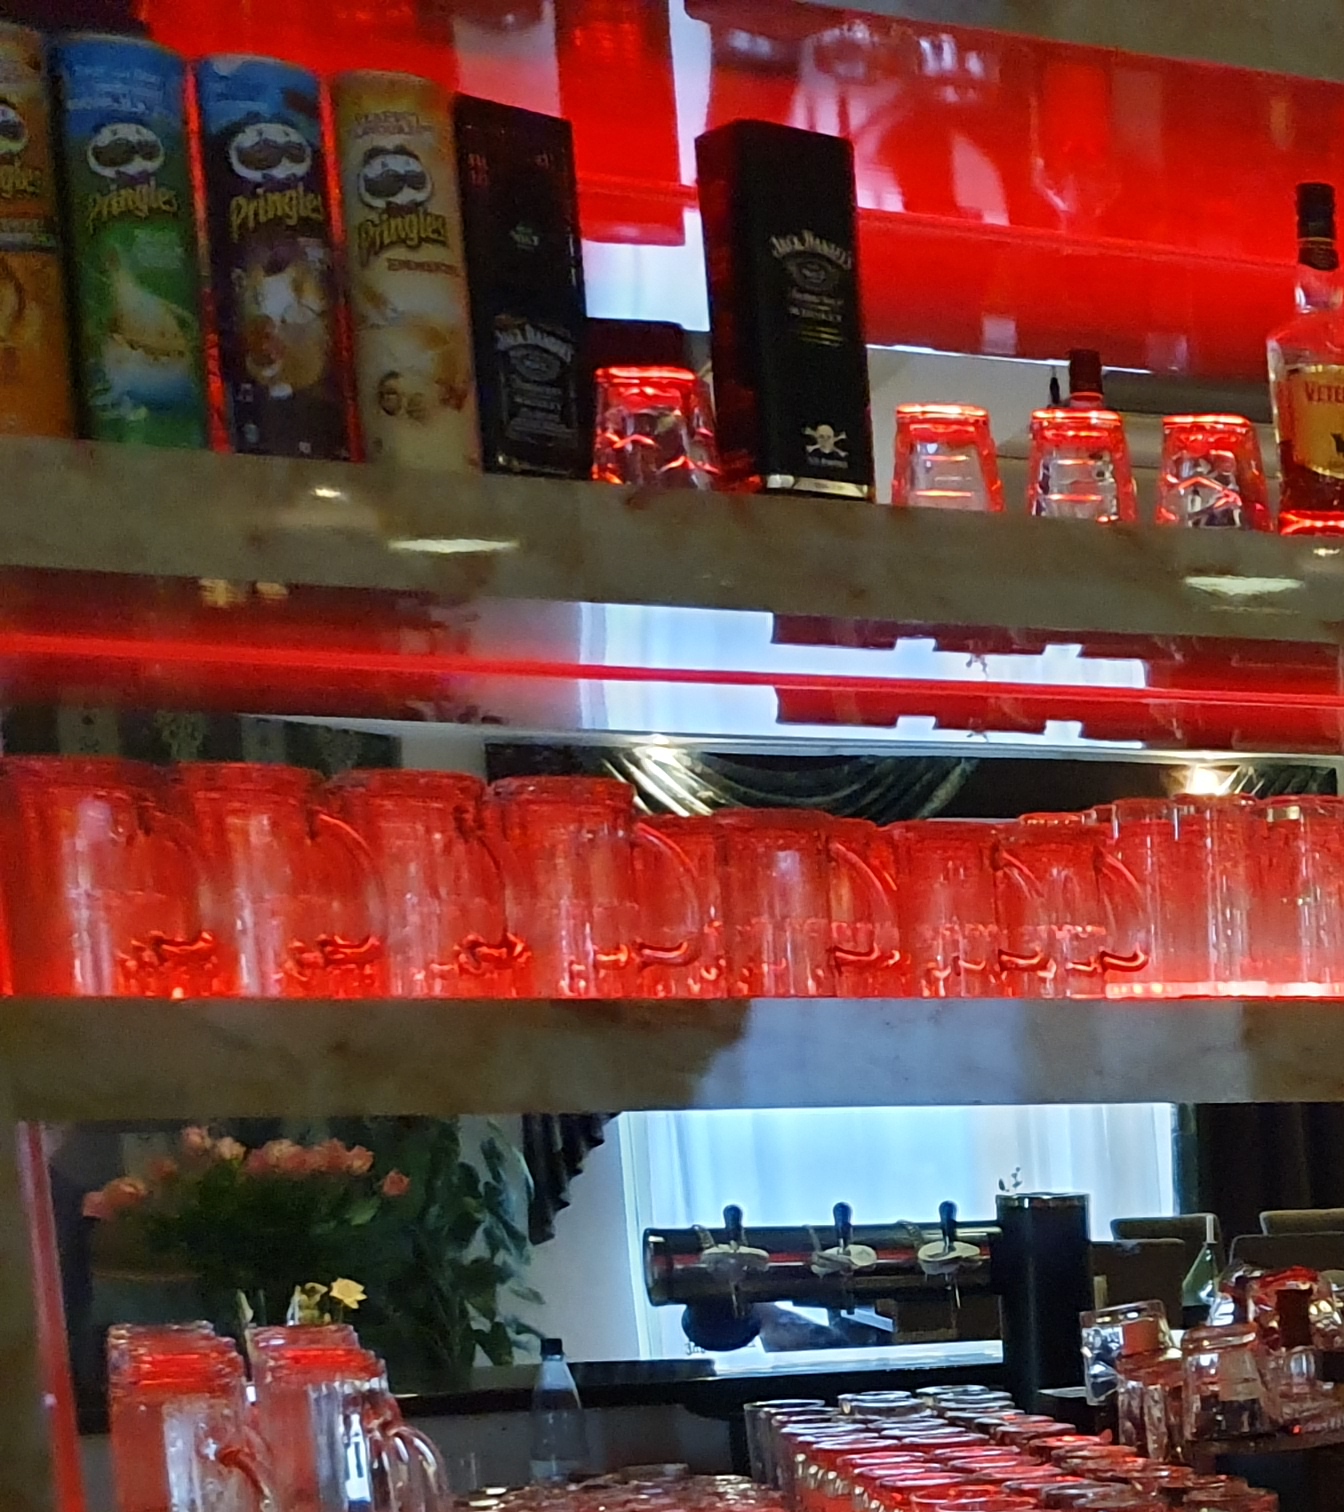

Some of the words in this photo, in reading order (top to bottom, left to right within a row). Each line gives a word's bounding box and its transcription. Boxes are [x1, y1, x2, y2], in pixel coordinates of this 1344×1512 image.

[87, 182, 179, 234] Pringles
[229, 182, 325, 242] Pringles
[356, 200, 450, 266] Pringles
